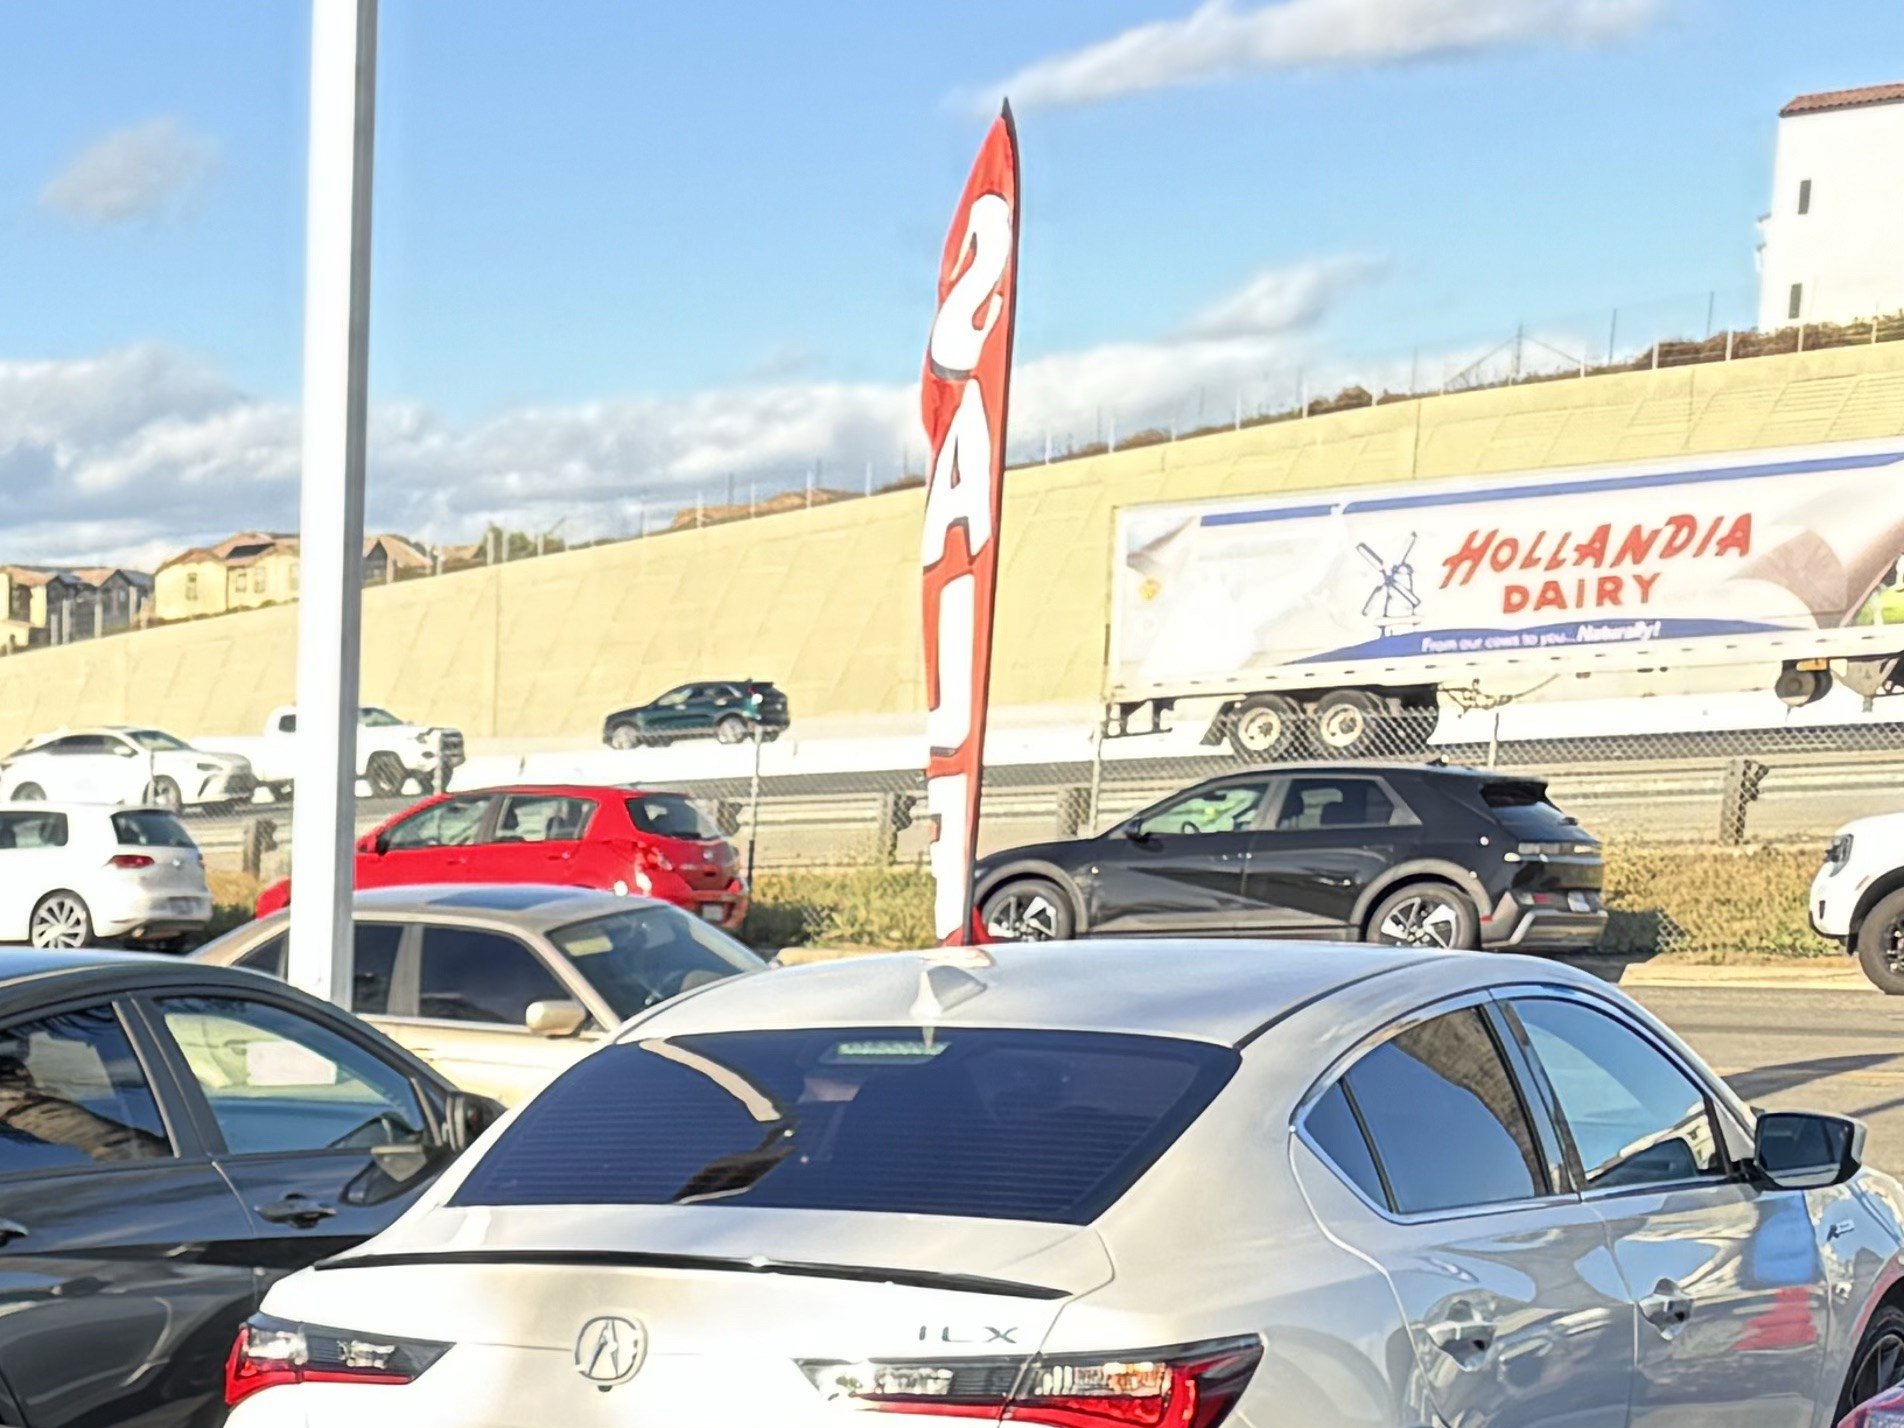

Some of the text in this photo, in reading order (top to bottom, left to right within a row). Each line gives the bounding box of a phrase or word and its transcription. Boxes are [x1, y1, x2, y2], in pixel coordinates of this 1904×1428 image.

[1438, 512, 1753, 590] HOLLANDIA
[1502, 572, 1661, 614] DAIRY
[1421, 636, 1458, 653] From
[1458, 637, 1484, 650] our
[1484, 634, 1520, 648] cows
[1521, 633, 1538, 646] to
[1576, 620, 1662, 643] Naturally!
[918, 1325, 1019, 1344] ILX
